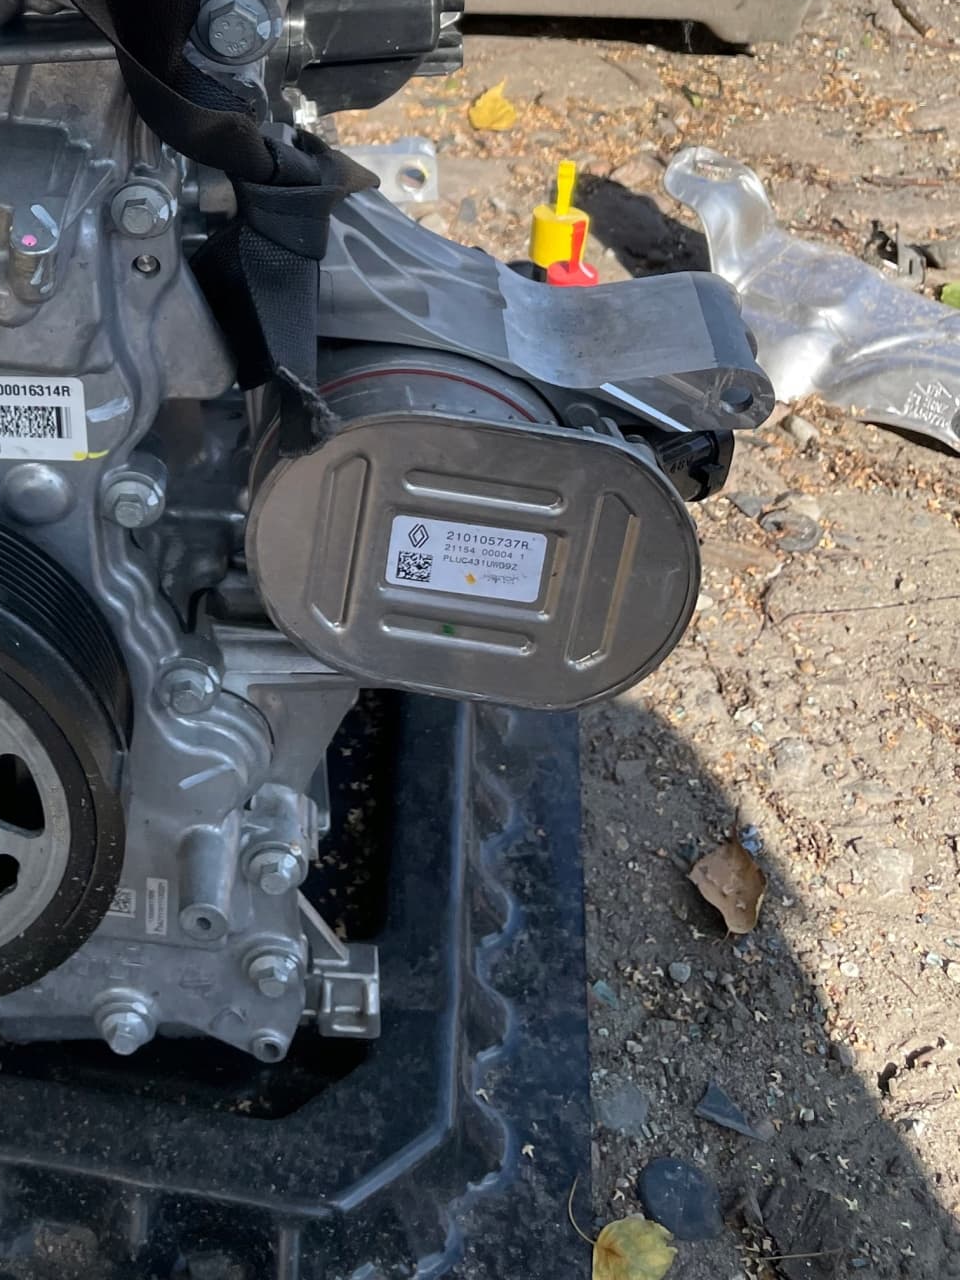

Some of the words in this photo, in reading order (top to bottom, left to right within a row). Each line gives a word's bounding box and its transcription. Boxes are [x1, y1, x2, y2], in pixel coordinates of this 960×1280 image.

[446, 530, 529, 550] 210105737R
[444, 543, 476, 554] 21154
[481, 548, 513, 559] 00004
